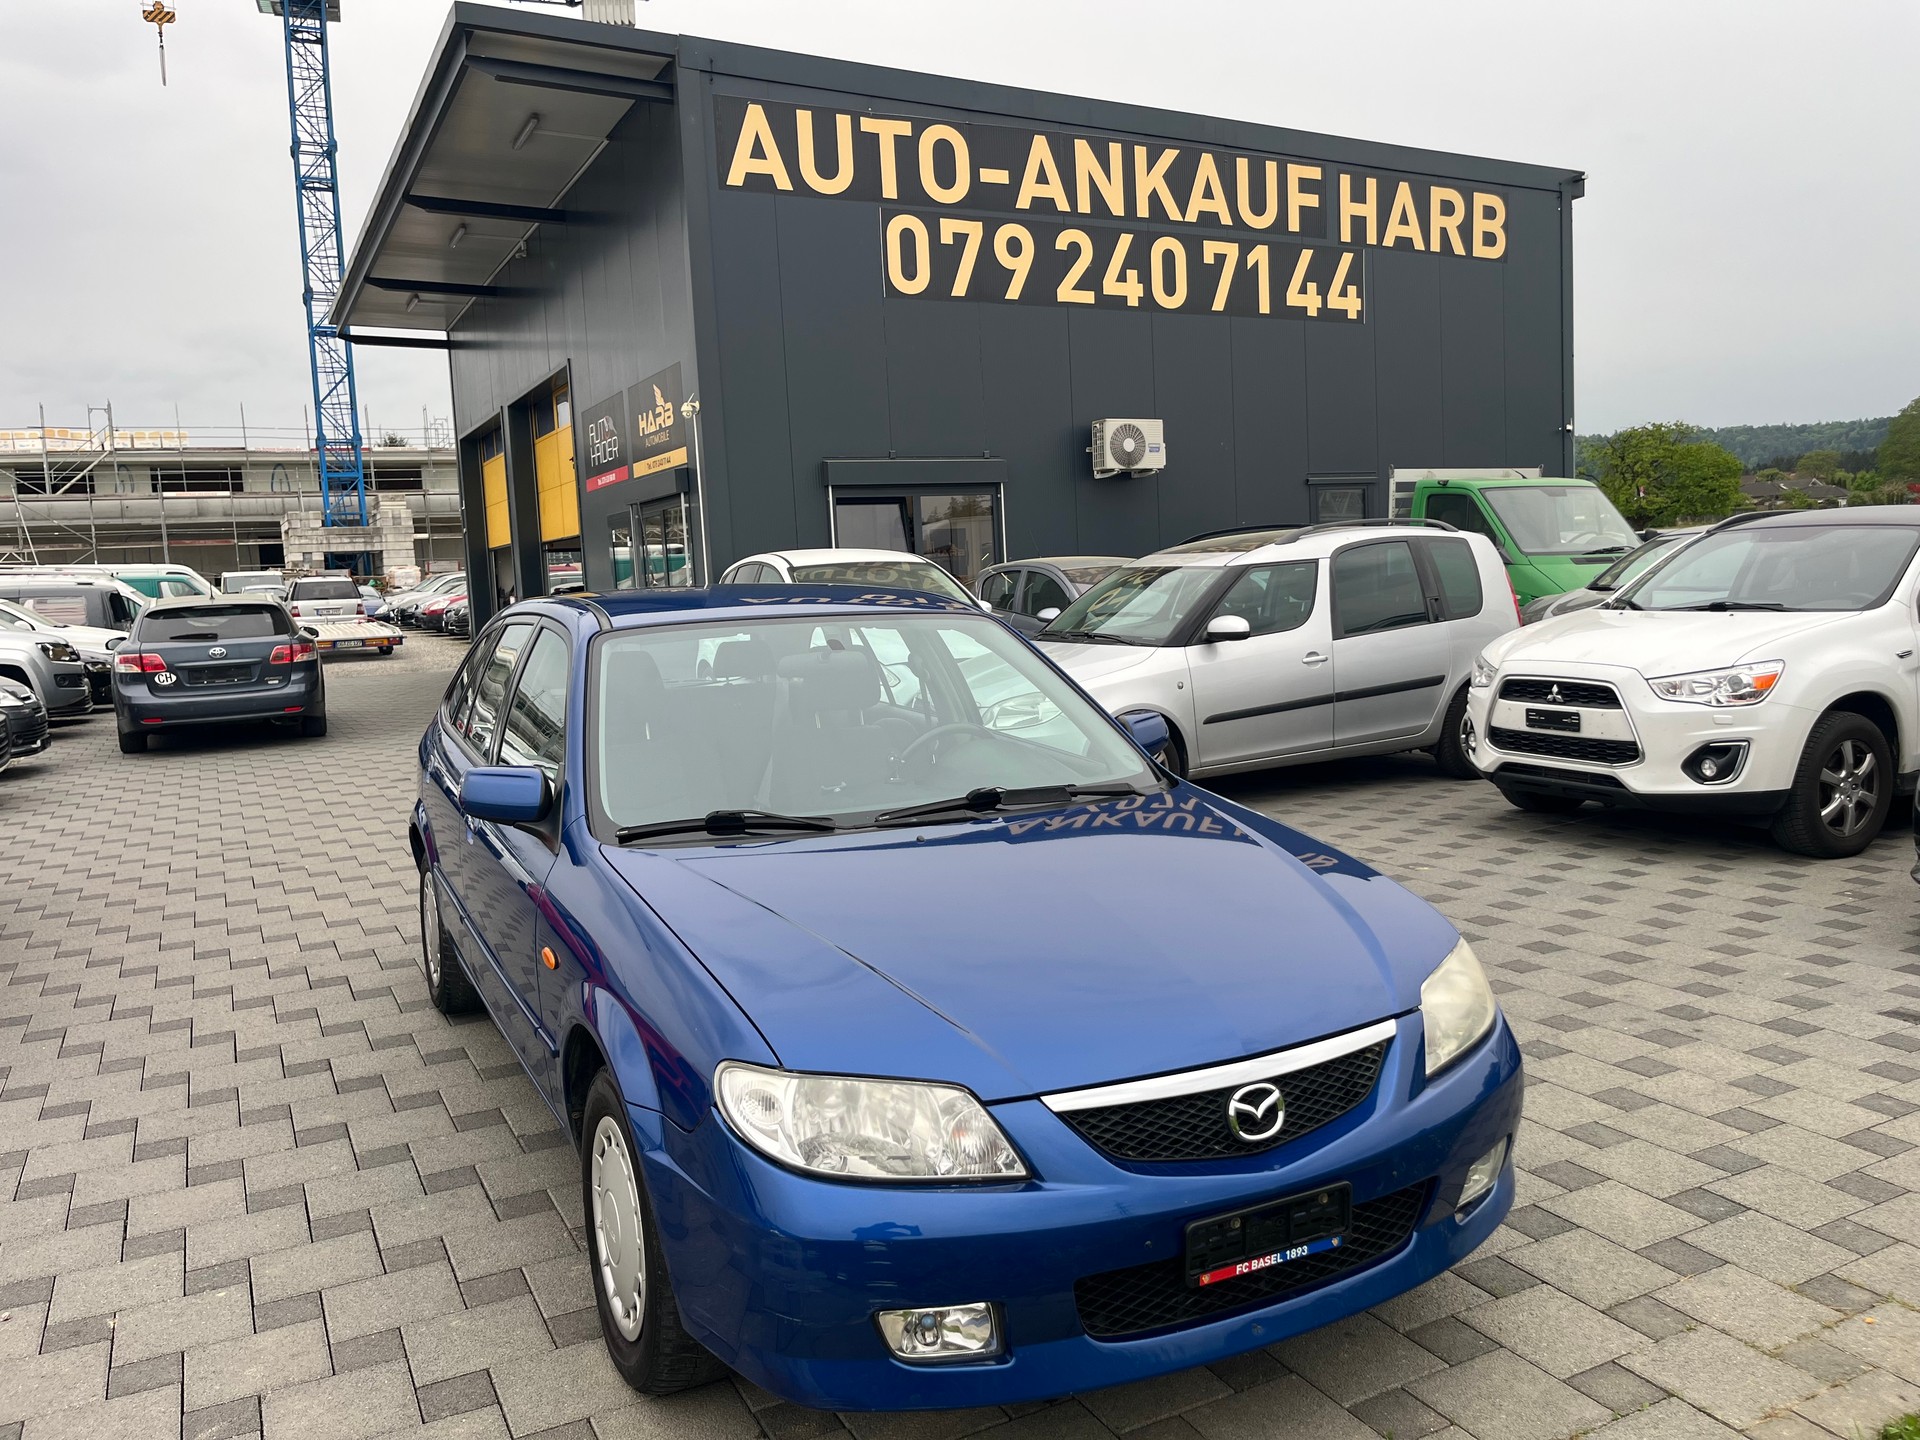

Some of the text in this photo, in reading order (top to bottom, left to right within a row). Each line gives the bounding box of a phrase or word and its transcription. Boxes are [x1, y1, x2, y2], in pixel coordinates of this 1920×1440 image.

[727, 104, 1506, 259] AUTO-ANKAUF HARB
[887, 214, 1035, 300] 079
[1055, 228, 1188, 309] 240
[638, 402, 674, 436] HARB
[645, 429, 670, 447] AUTOMOBILE
[157, 673, 173, 684] CH
[1236, 1245, 1308, 1275] FC BASEL 1893
